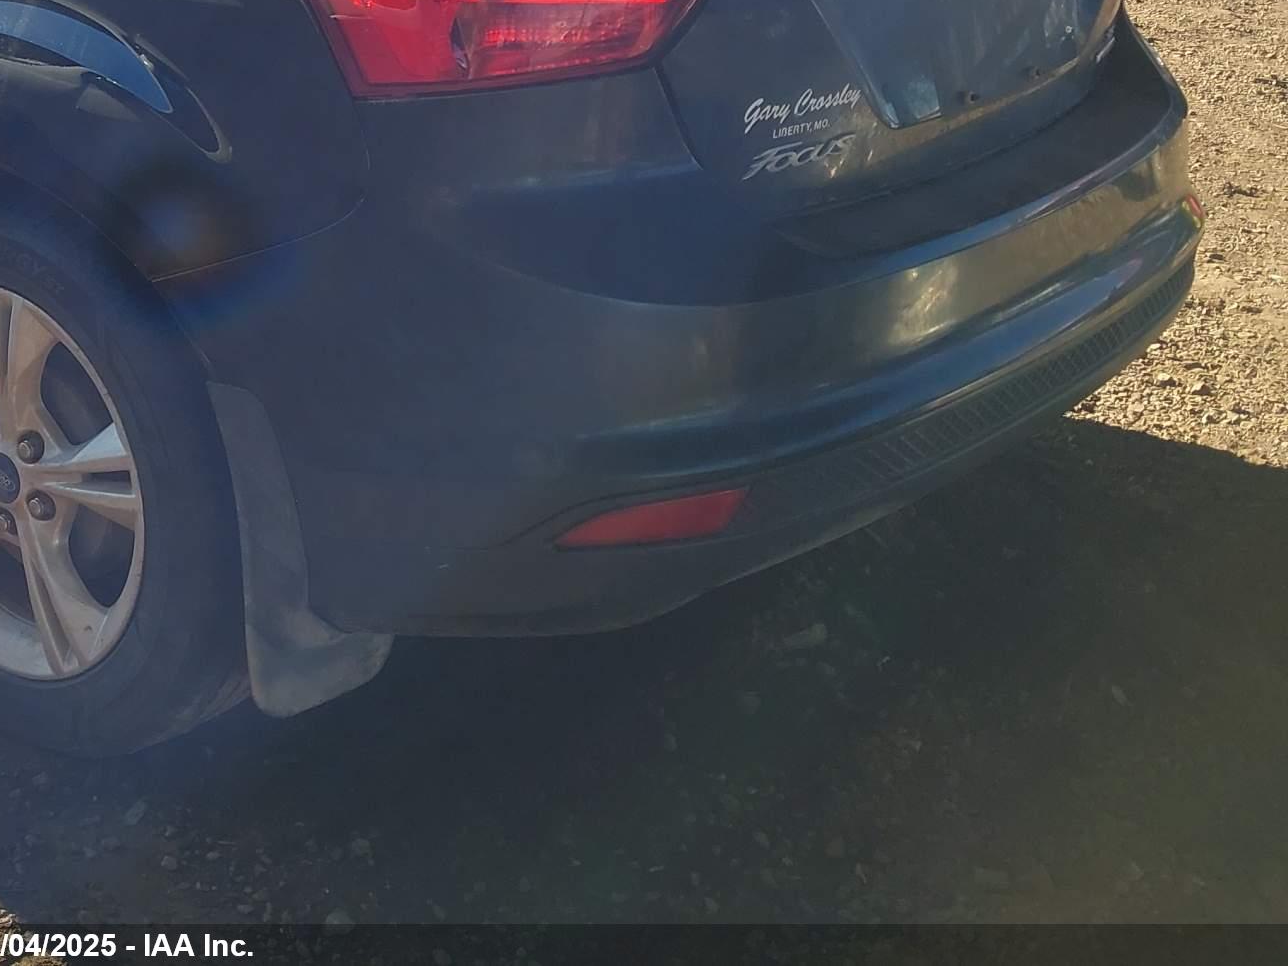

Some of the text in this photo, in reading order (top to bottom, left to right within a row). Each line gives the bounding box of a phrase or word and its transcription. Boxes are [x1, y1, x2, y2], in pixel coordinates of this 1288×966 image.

[744, 83, 861, 134] Gary Crossley
[814, 118, 830, 131] MO.
